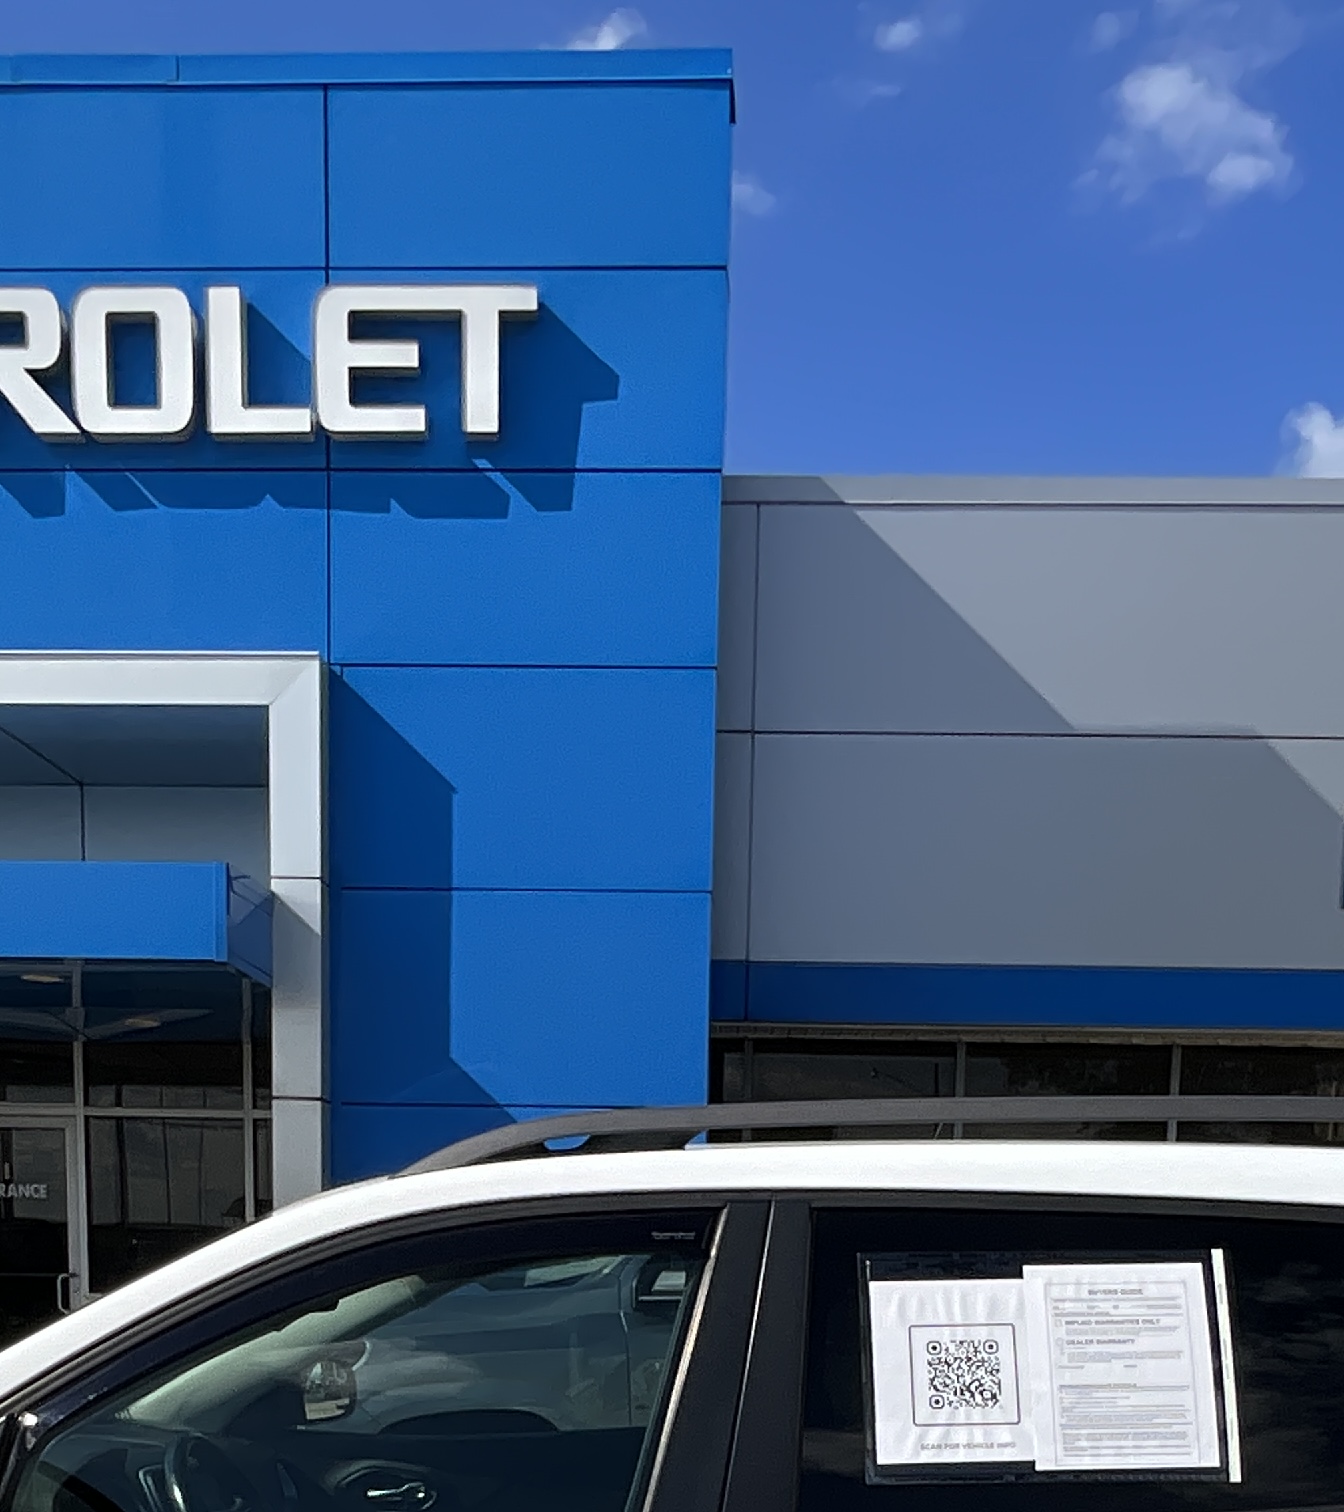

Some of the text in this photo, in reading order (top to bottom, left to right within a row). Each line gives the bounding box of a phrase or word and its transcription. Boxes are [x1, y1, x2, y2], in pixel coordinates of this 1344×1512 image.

[920, 1441, 1017, 1451] SCAN FOR VEHICLE INFO
